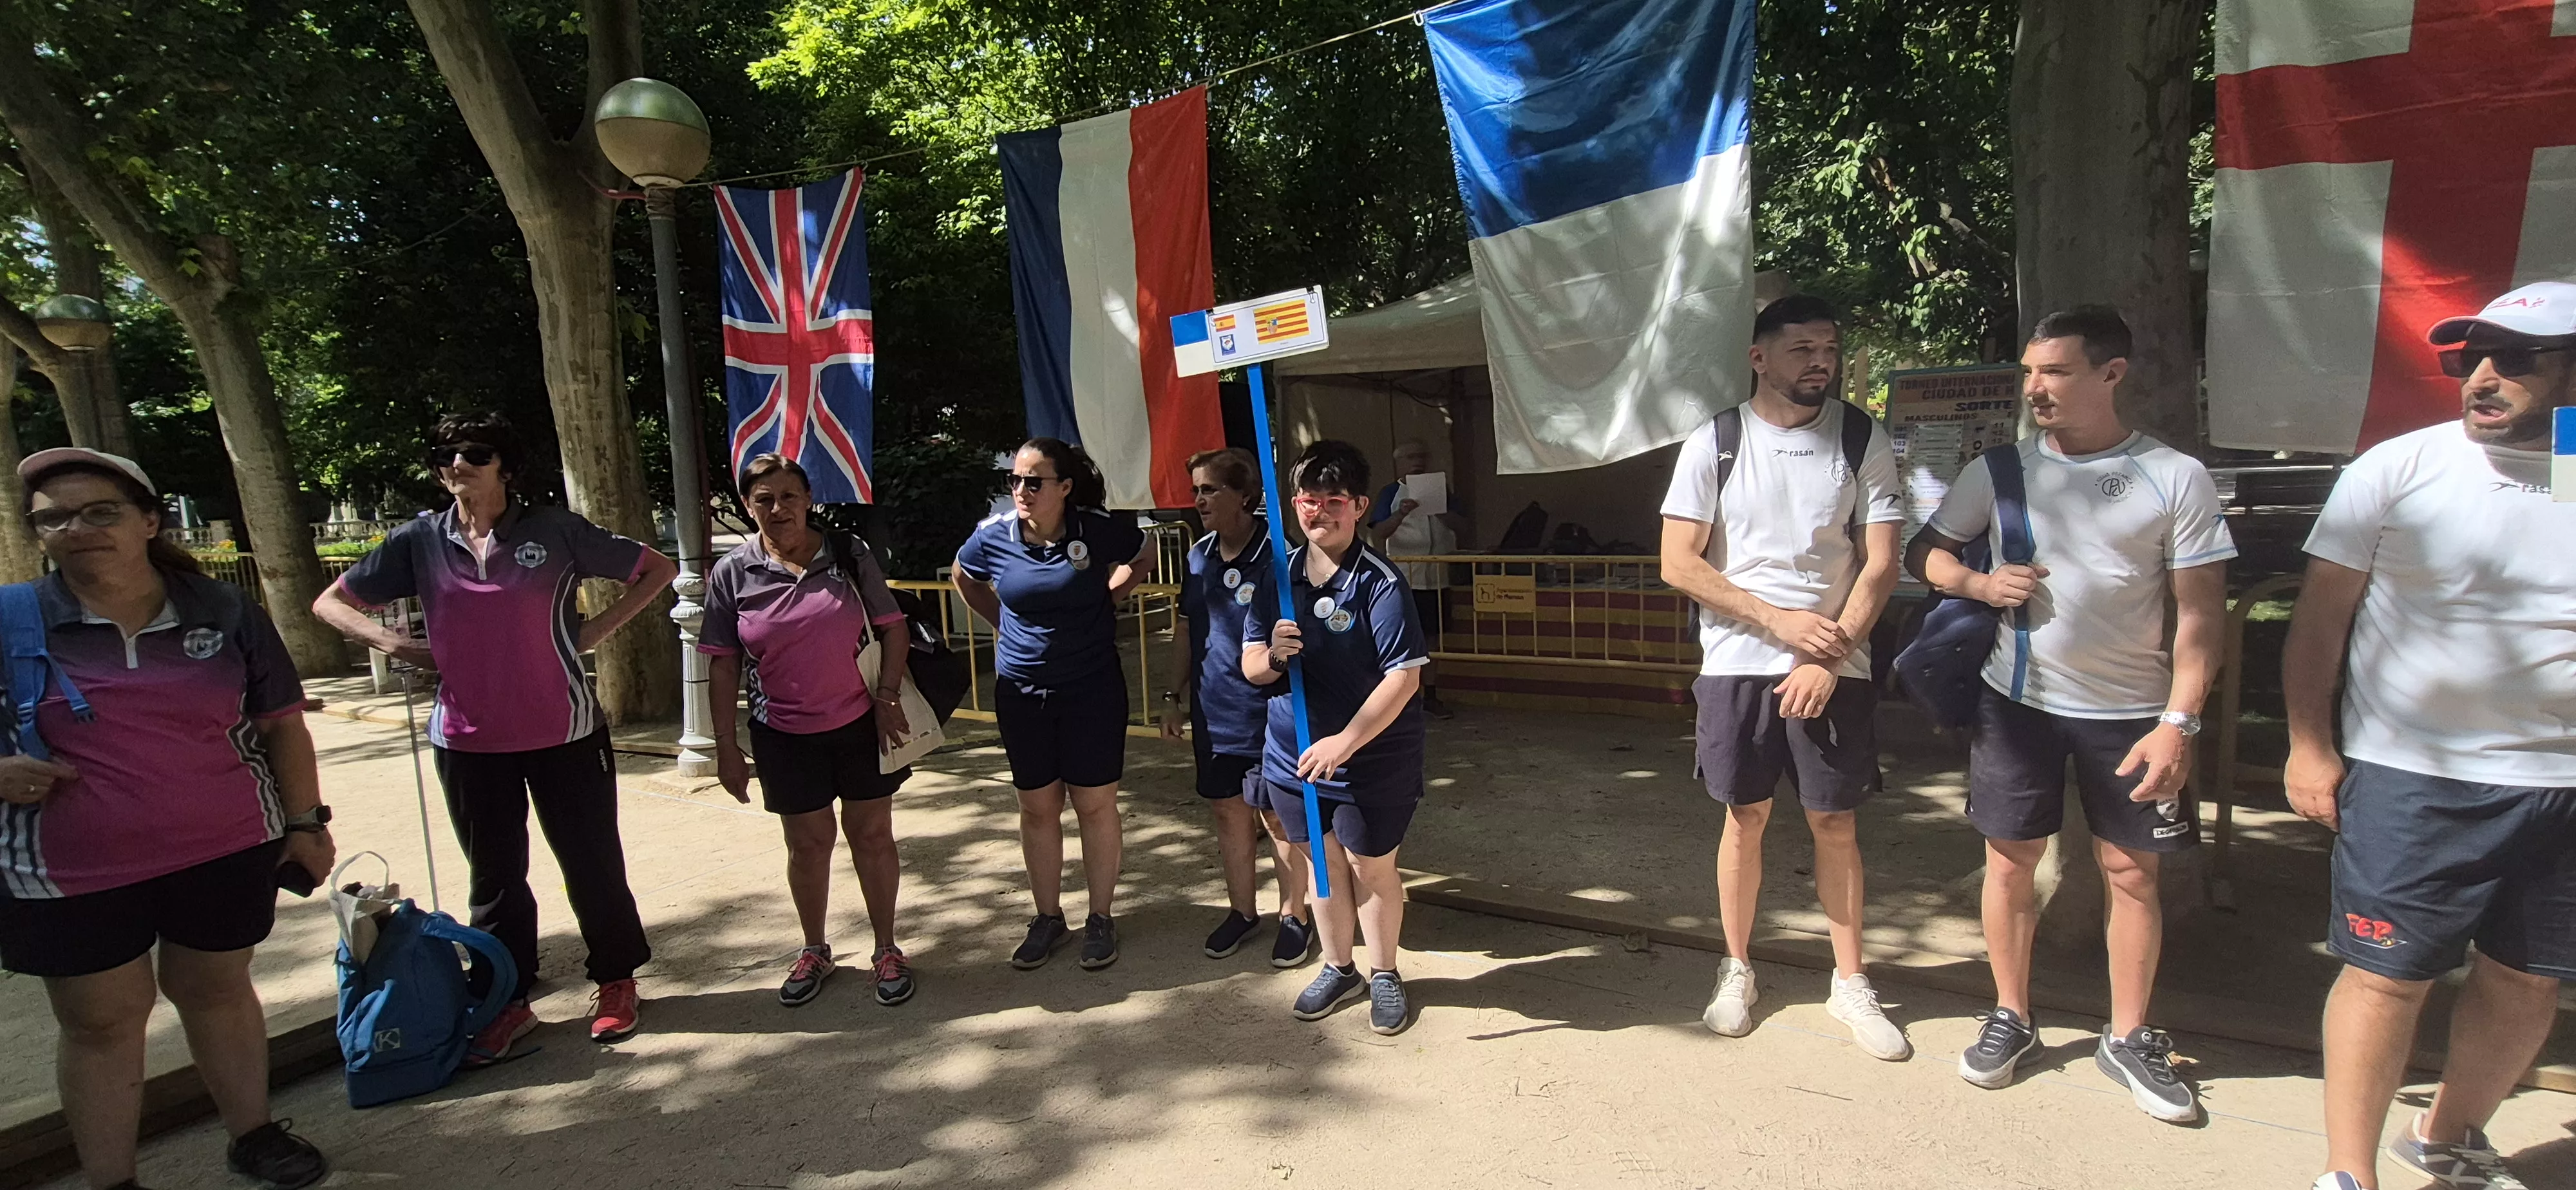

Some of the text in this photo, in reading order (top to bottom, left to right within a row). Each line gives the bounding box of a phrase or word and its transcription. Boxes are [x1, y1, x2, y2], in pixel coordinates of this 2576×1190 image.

[1922, 388, 1976, 400] CIUDAD
[1983, 386, 2000, 397] DE
[1954, 400, 2014, 411] SORTE
[1904, 412, 1978, 422] MASCULINOS
[1790, 448, 1814, 457] rasán
